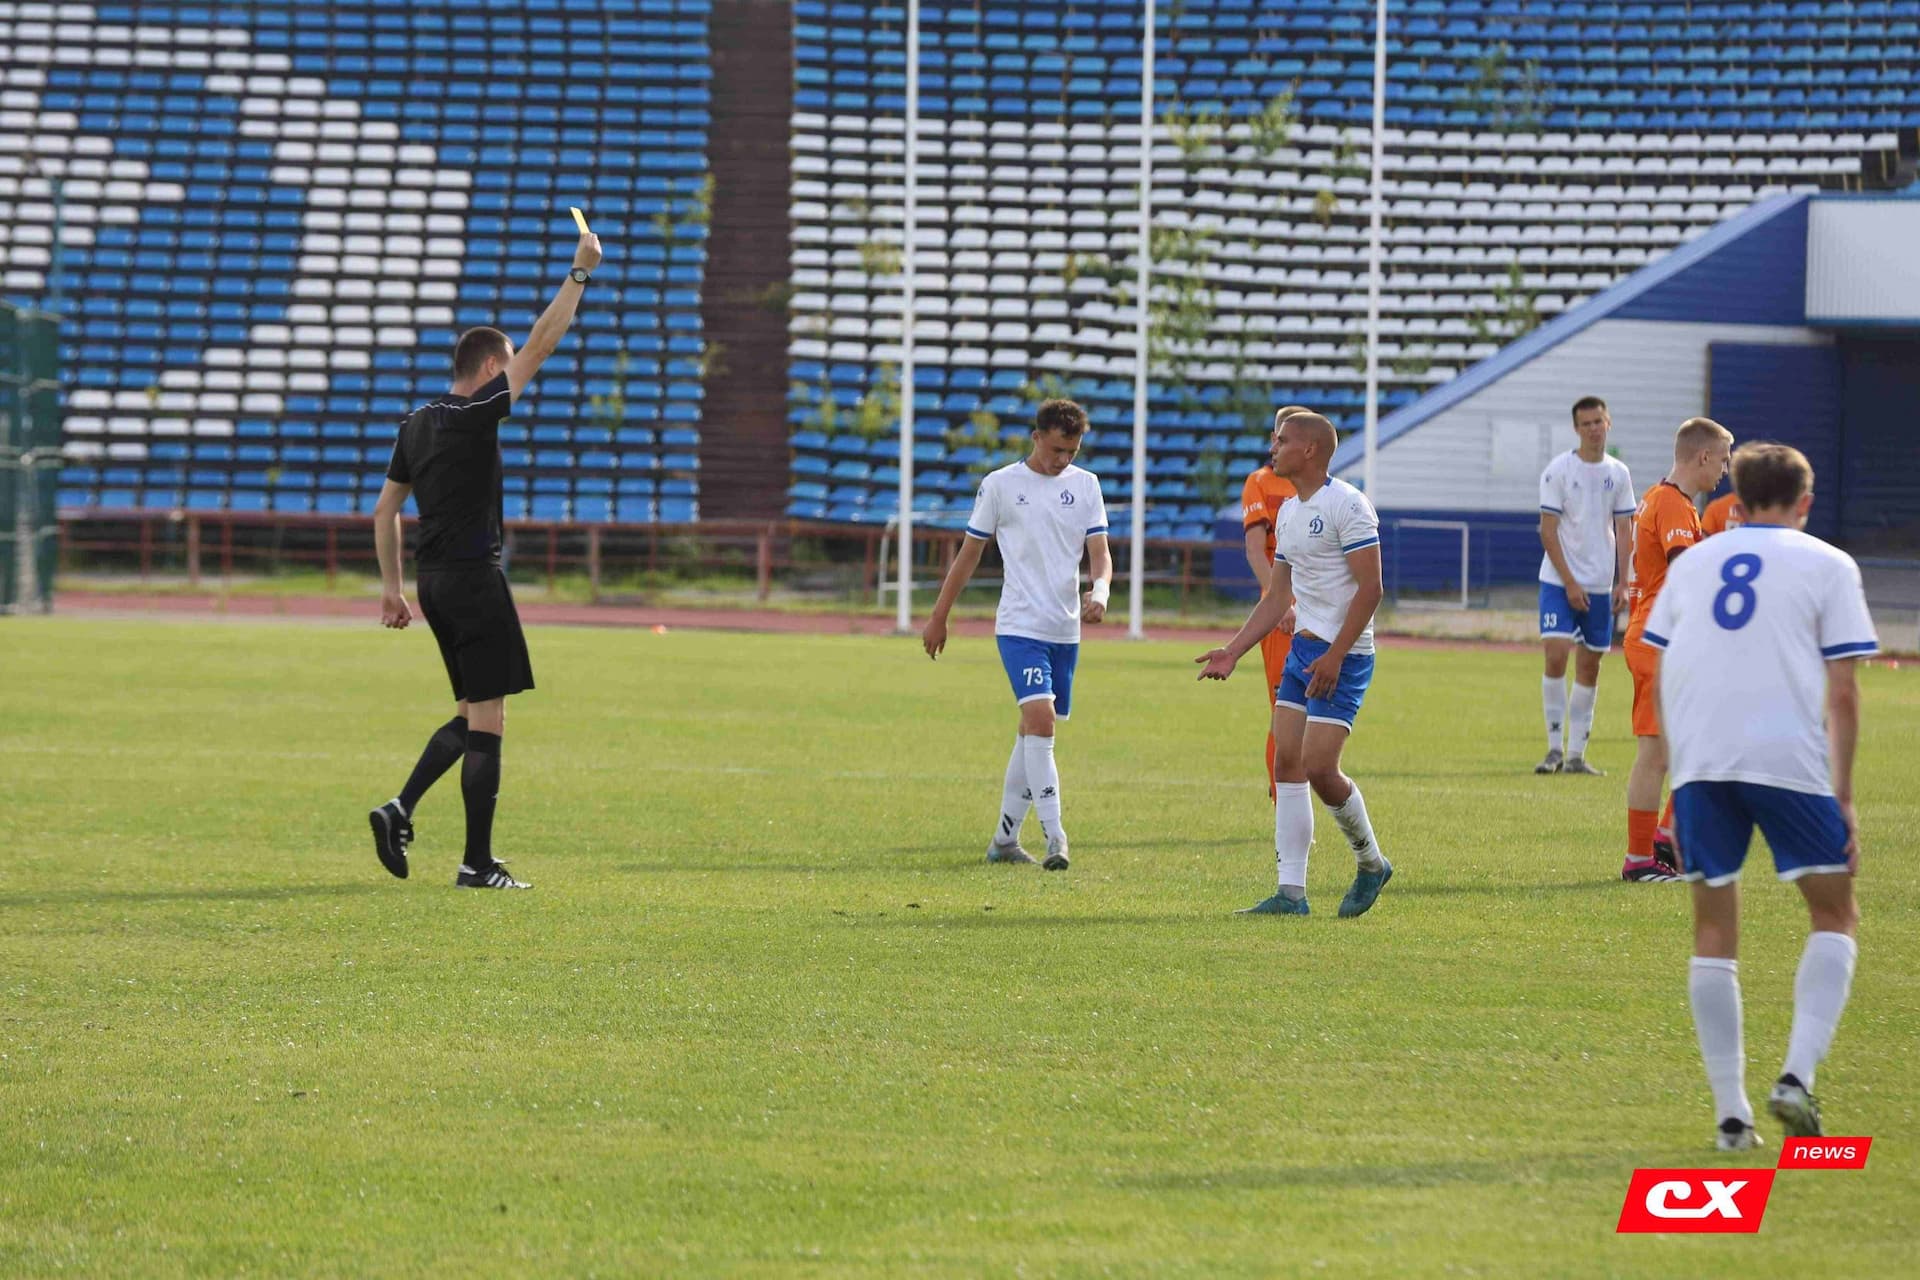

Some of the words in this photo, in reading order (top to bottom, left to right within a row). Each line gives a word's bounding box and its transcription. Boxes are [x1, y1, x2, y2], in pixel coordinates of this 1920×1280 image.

[1713, 553, 1763, 630] 8
[1543, 612, 1558, 629] 33
[1023, 667, 1044, 686] 73
